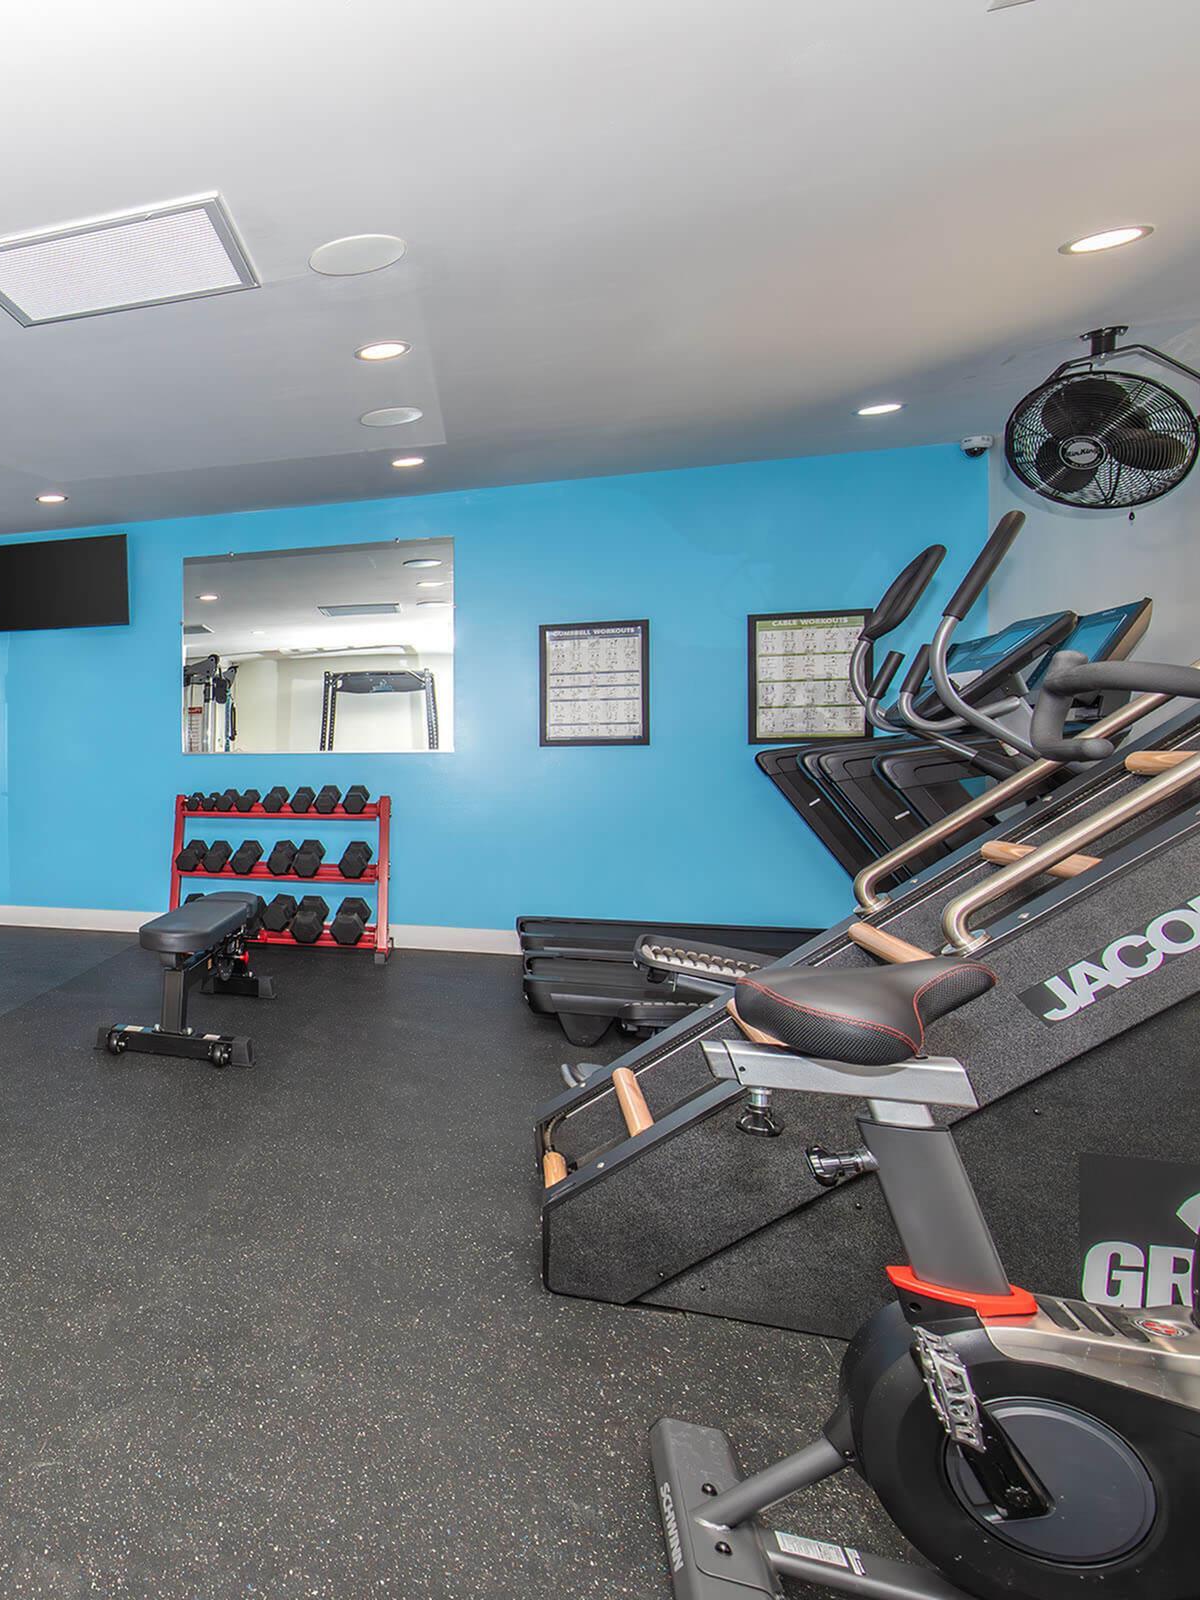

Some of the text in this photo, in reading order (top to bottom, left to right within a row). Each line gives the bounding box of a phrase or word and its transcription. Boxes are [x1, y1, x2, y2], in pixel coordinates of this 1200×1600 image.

[593, 626, 635, 636] WORKOUTS
[771, 616, 849, 627] CABLE WORKOUTS
[1043, 894, 1200, 1021] JACO
[659, 1481, 685, 1574] SCHWINN
